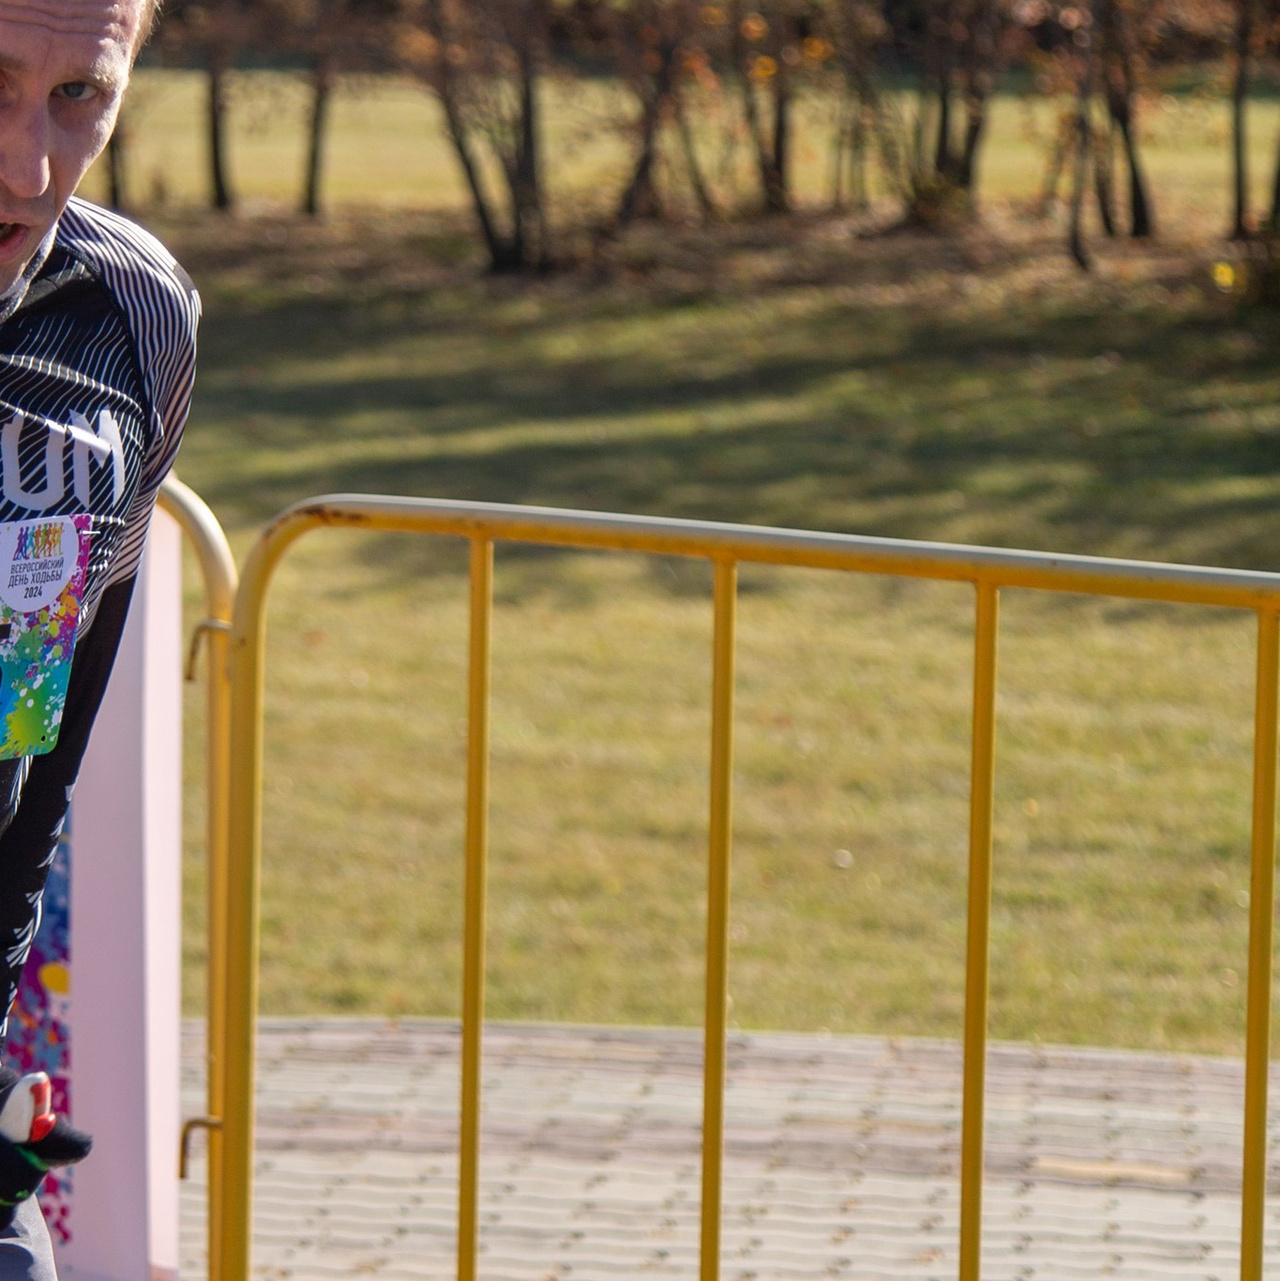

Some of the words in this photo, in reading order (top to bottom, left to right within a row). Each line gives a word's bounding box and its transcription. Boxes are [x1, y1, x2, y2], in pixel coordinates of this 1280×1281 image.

[10, 557, 65, 574] ВСЕРОССИЙСКИЙ
[7, 574, 29, 588] ДЕНЬ
[30, 570, 63, 584] ХОДЬБЫ
[23, 586, 43, 599] 2024
